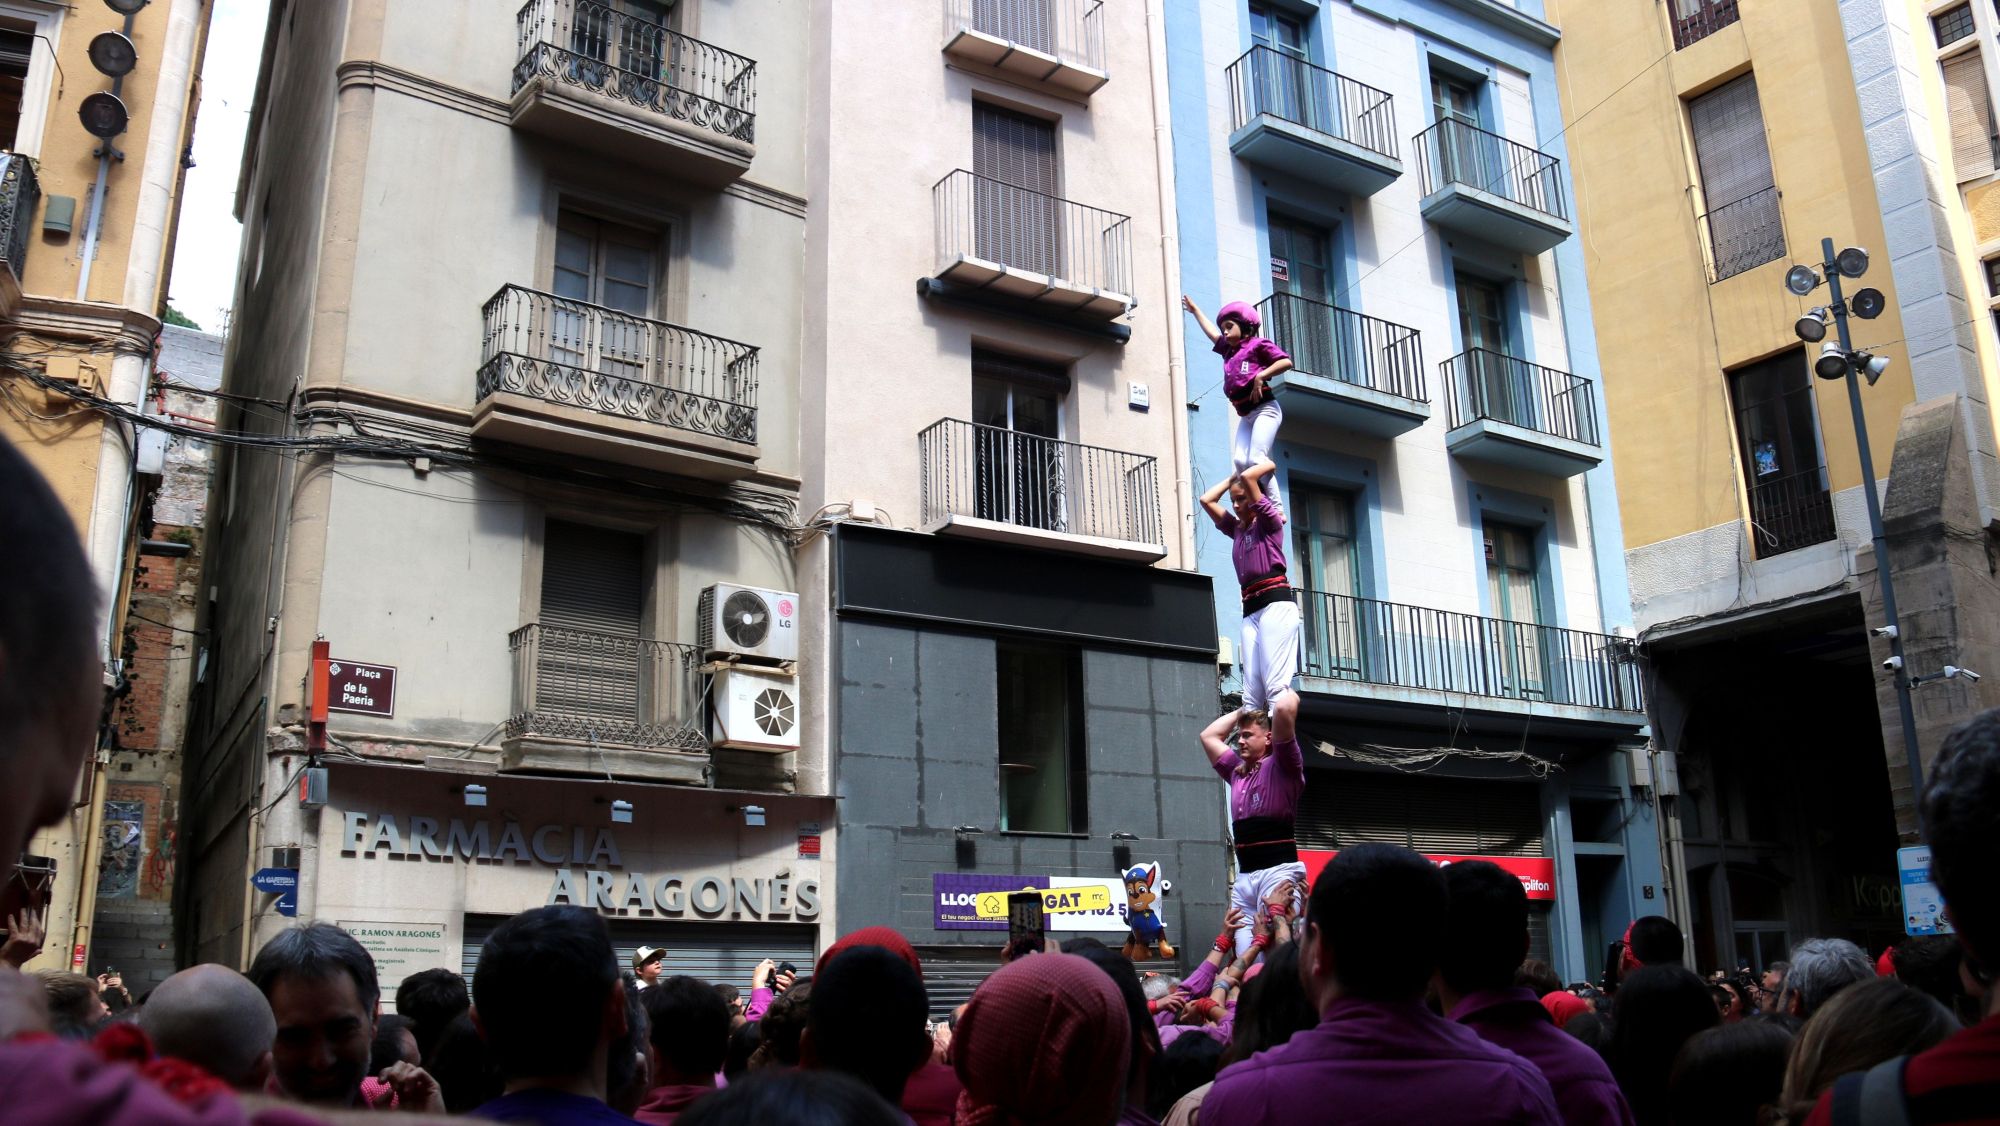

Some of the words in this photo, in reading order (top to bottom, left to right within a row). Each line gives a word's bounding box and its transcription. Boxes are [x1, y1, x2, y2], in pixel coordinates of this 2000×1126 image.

[779, 619, 791, 628] LG
[355, 667, 381, 679] Plaça
[343, 682, 356, 692] de
[358, 683, 367, 694] la
[342, 692, 373, 706] Paeria
[341, 811, 623, 868] FARMÀCIA
[1521, 879, 1550, 893] plifon
[547, 866, 821, 921] ARAGONÉS
[1040, 892, 1082, 910] GAT
[361, 929, 394, 938] RAMON
[395, 930, 441, 938] ARAGONÉS
